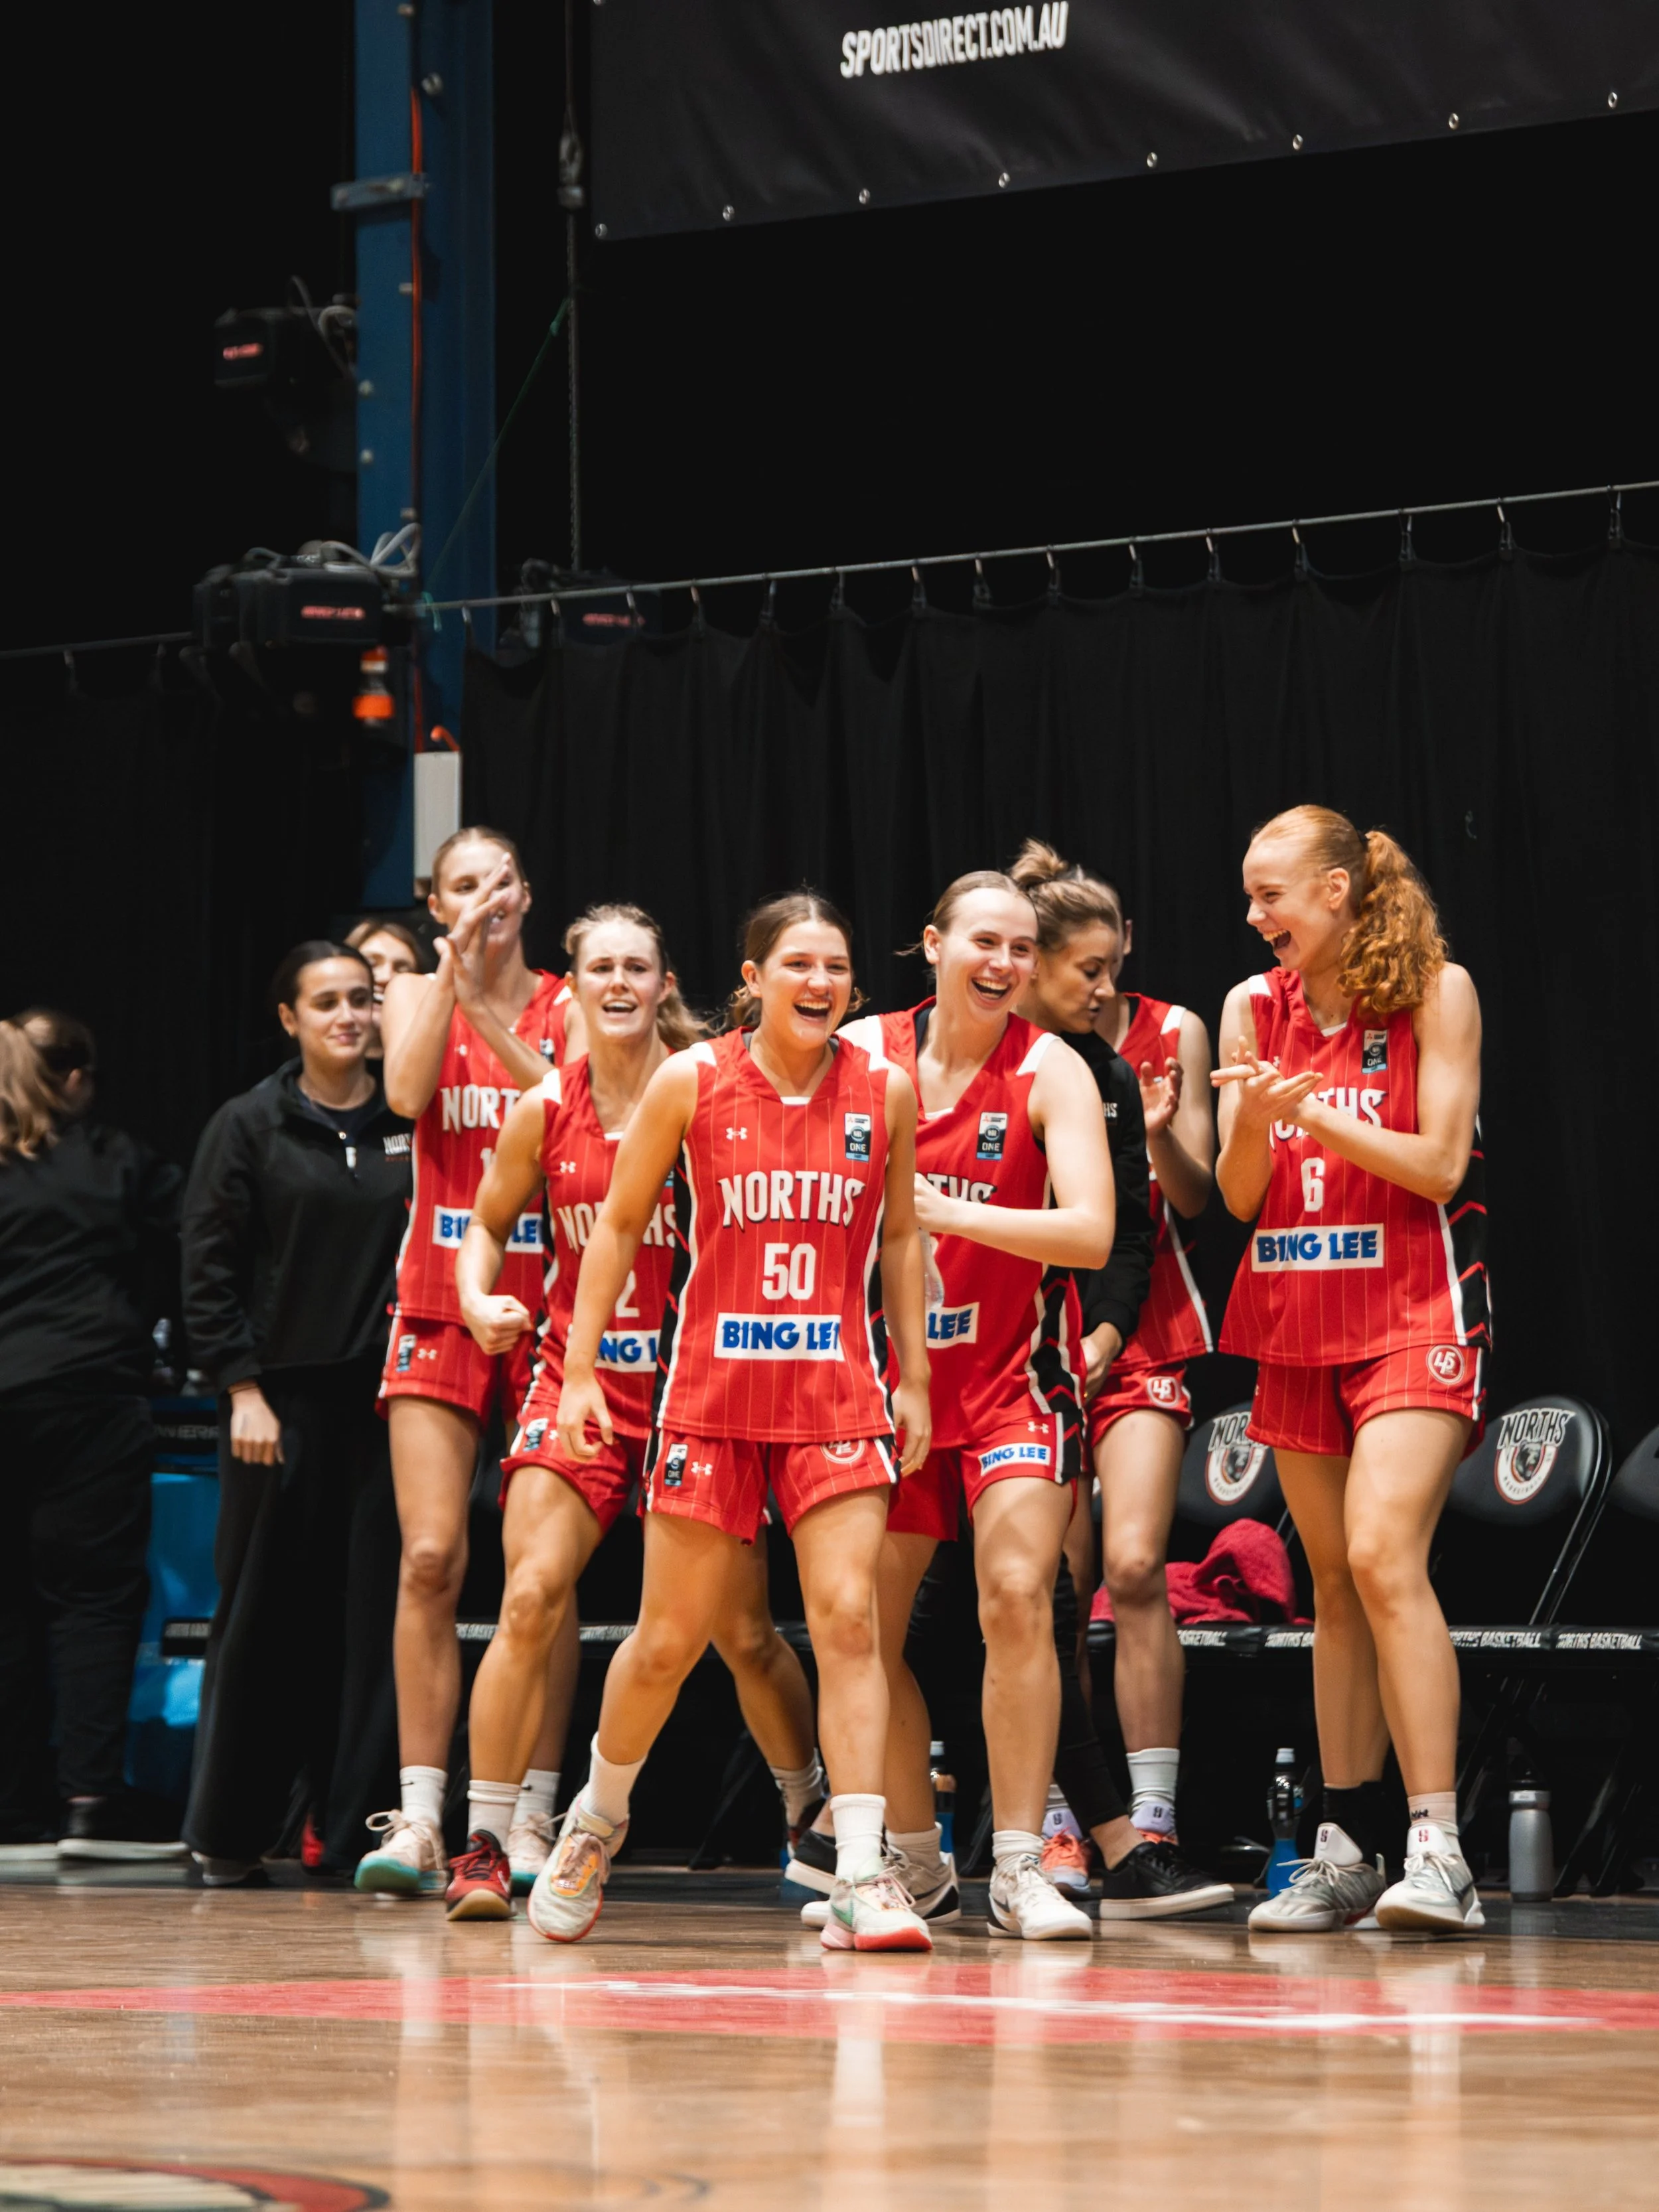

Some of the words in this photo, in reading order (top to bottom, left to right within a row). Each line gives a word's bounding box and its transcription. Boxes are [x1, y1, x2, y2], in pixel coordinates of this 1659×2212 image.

[840, 1, 1069, 78] SPORTSDIRECT.COM.AU
[441, 1084, 522, 1134] NORT
[849, 1143, 867, 1153] ONE
[982, 1142, 1000, 1151] ONE
[718, 1170, 865, 1232] NORTHS
[1301, 1157, 1325, 1212] 6
[1257, 1233, 1322, 1263] BING
[1328, 1230, 1378, 1260] LEE
[762, 1242, 816, 1301] 50
[722, 1320, 800, 1351] BING
[927, 1308, 973, 1340] LEE
[1208, 1412, 1252, 1453] NOR
[1496, 1408, 1576, 1453] NORTHS
[1019, 1446, 1046, 1460] LEE
[1589, 1633, 1642, 1650] BASKETBALL
